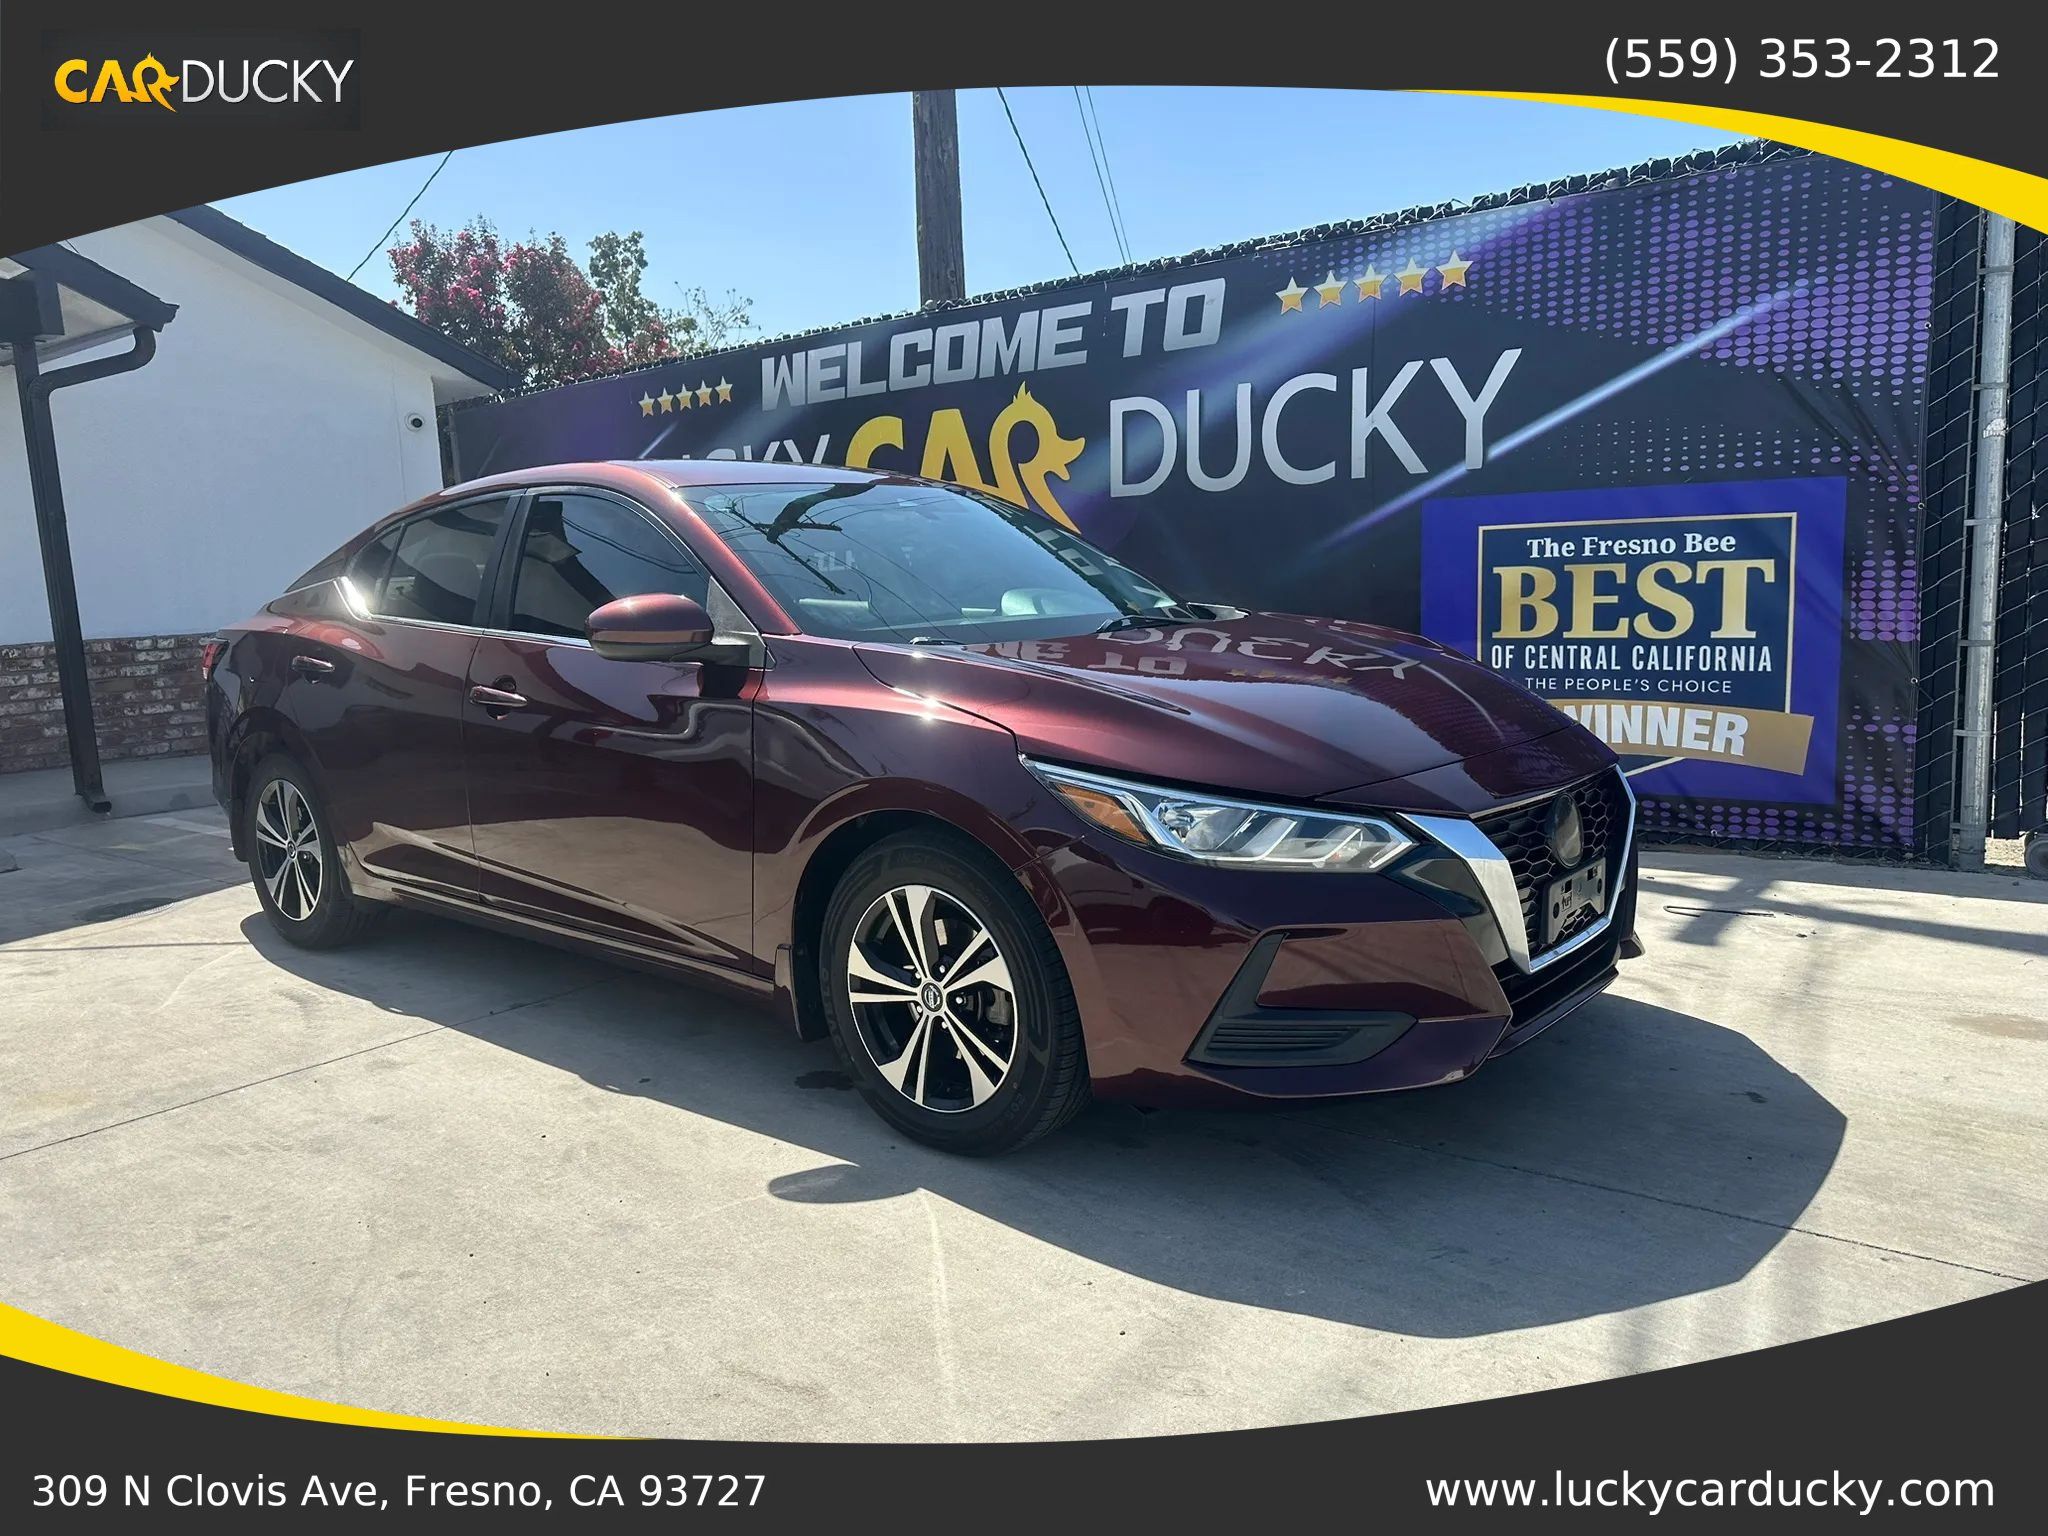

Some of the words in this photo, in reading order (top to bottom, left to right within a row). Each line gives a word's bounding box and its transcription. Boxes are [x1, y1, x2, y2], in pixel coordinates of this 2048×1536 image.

[761, 301, 1093, 411] WELCOME
[1111, 278, 1226, 356] TO
[1109, 348, 1523, 498] DUCKY
[1527, 537, 1575, 558] The
[1581, 534, 1677, 556] Fresno
[1684, 532, 1737, 554] Bee
[1491, 558, 1776, 640] BEST
[1491, 645, 1515, 669] OF
[1524, 645, 1622, 671] CENTRAL
[1631, 644, 1773, 673] CALIFORNIA
[1525, 677, 1558, 690] THE
[1564, 677, 1650, 693] PEOPLE'S
[1657, 679, 1732, 694] CHOICE
